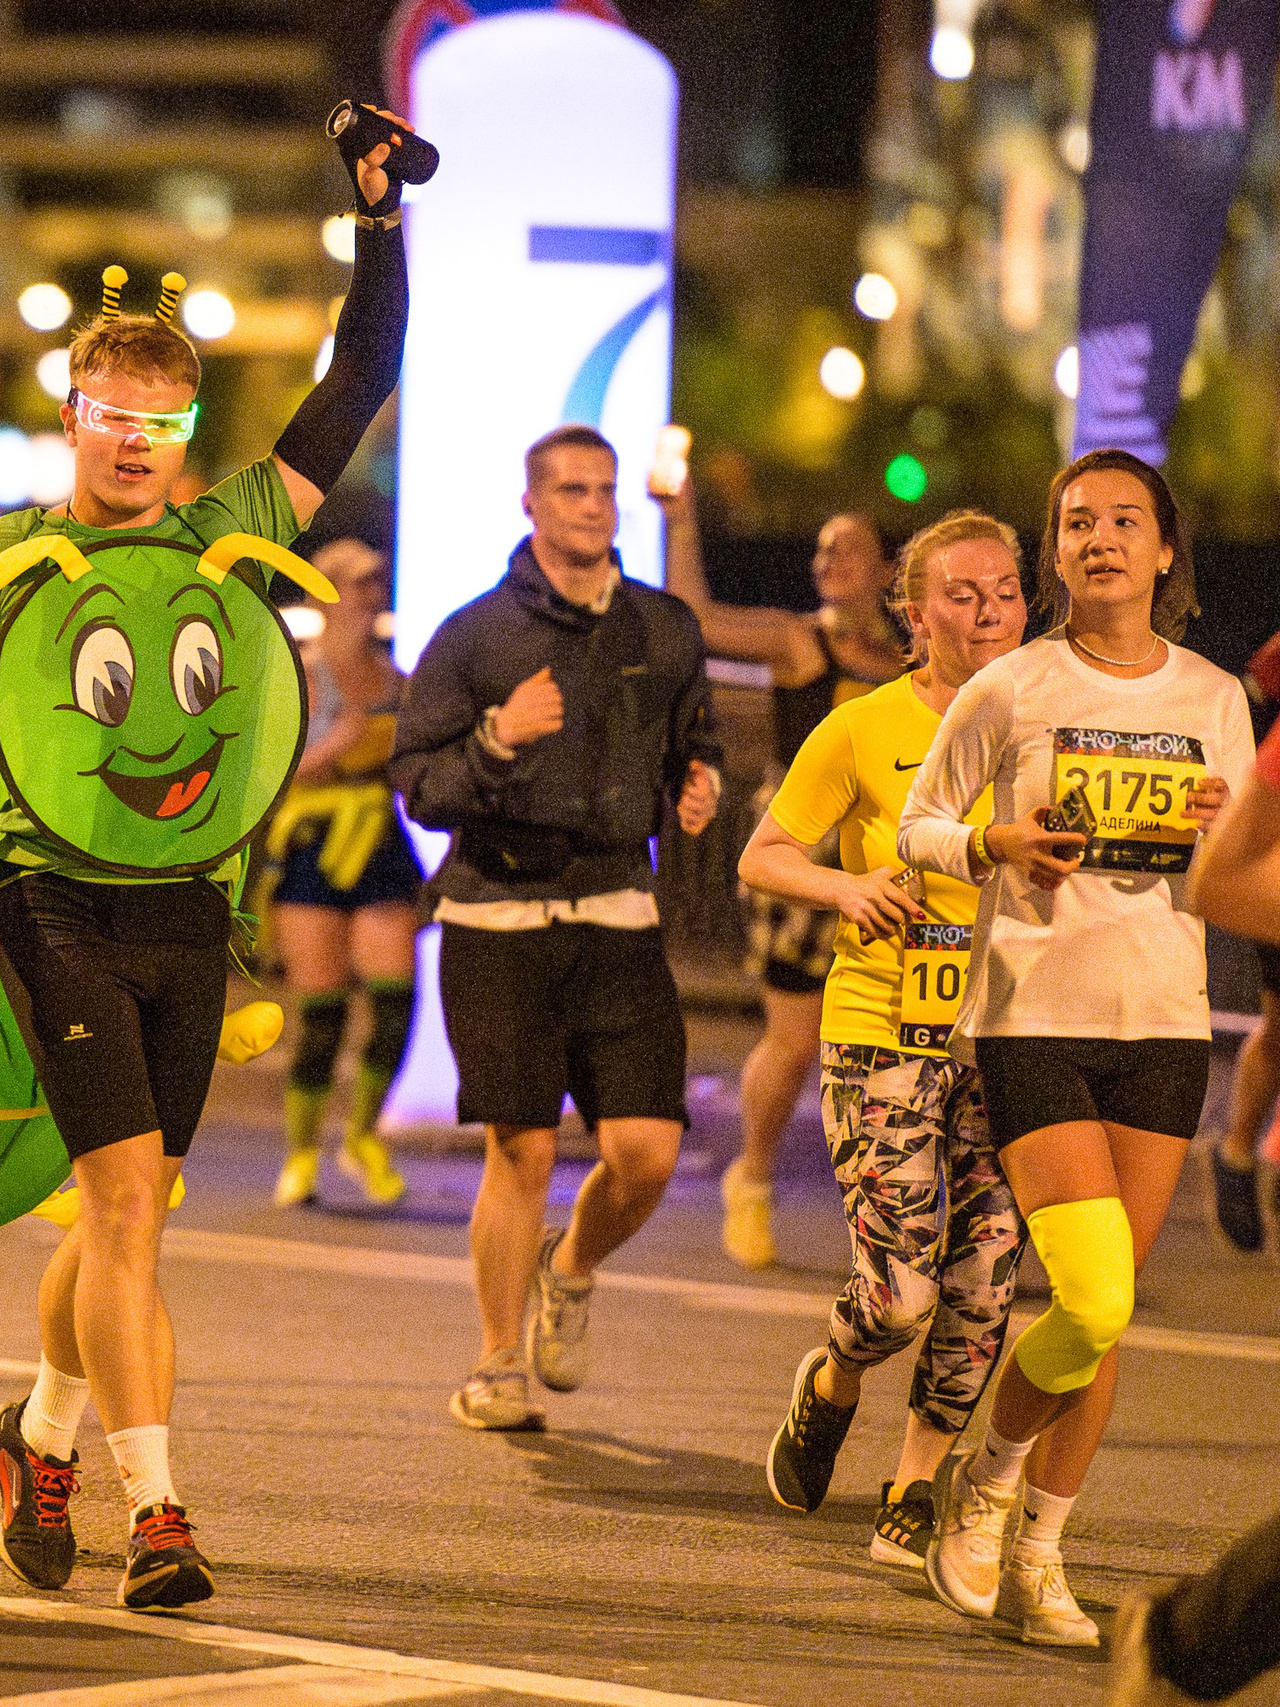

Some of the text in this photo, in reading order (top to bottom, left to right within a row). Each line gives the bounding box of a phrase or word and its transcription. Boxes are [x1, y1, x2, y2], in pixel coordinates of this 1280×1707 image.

[526, 225, 673, 426] 7
[1100, 816, 1161, 833] АДЕЛИНА
[912, 962, 969, 1001] 10
[914, 1027, 931, 1046] G
